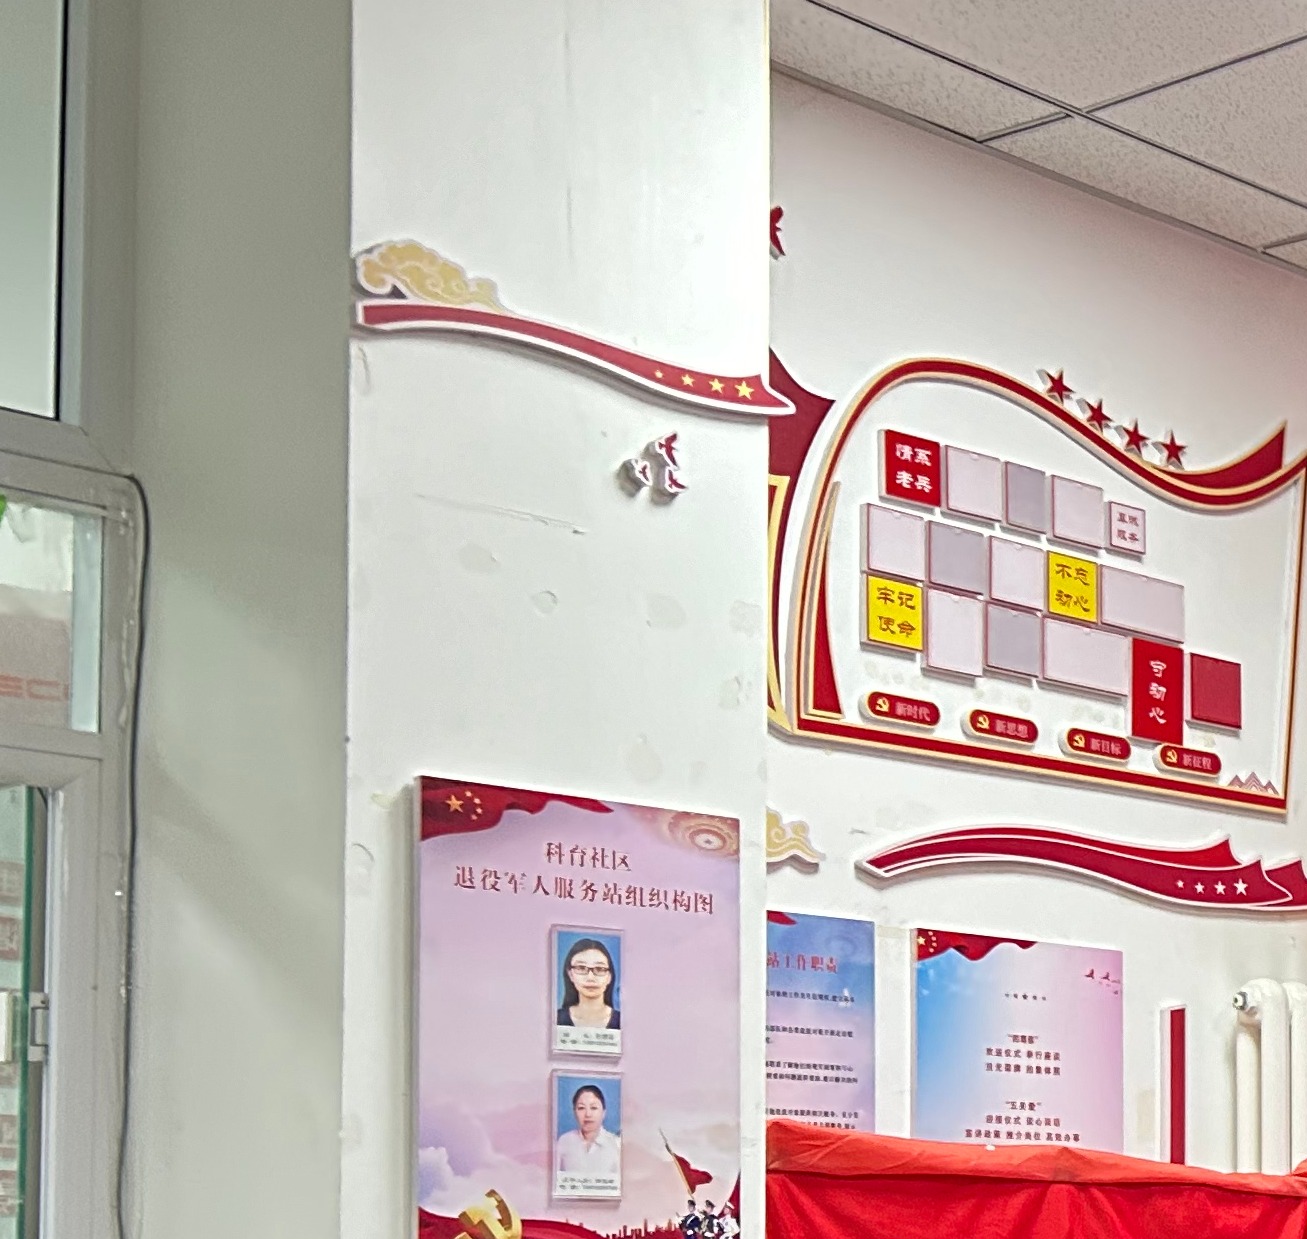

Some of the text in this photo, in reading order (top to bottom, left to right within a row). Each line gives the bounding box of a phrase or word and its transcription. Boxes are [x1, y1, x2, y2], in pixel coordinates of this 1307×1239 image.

[1054, 562, 1090, 587] 不忘
[876, 586, 917, 611] 牢记
[1054, 590, 1091, 614] 初心
[877, 615, 917, 638] 使命
[894, 701, 931, 722] 新时代
[994, 718, 1030, 740] 新思想
[1089, 736, 1122, 757] 新目标
[545, 841, 631, 873] 科育社区
[453, 864, 715, 915] 退役军人服务站组织构图
